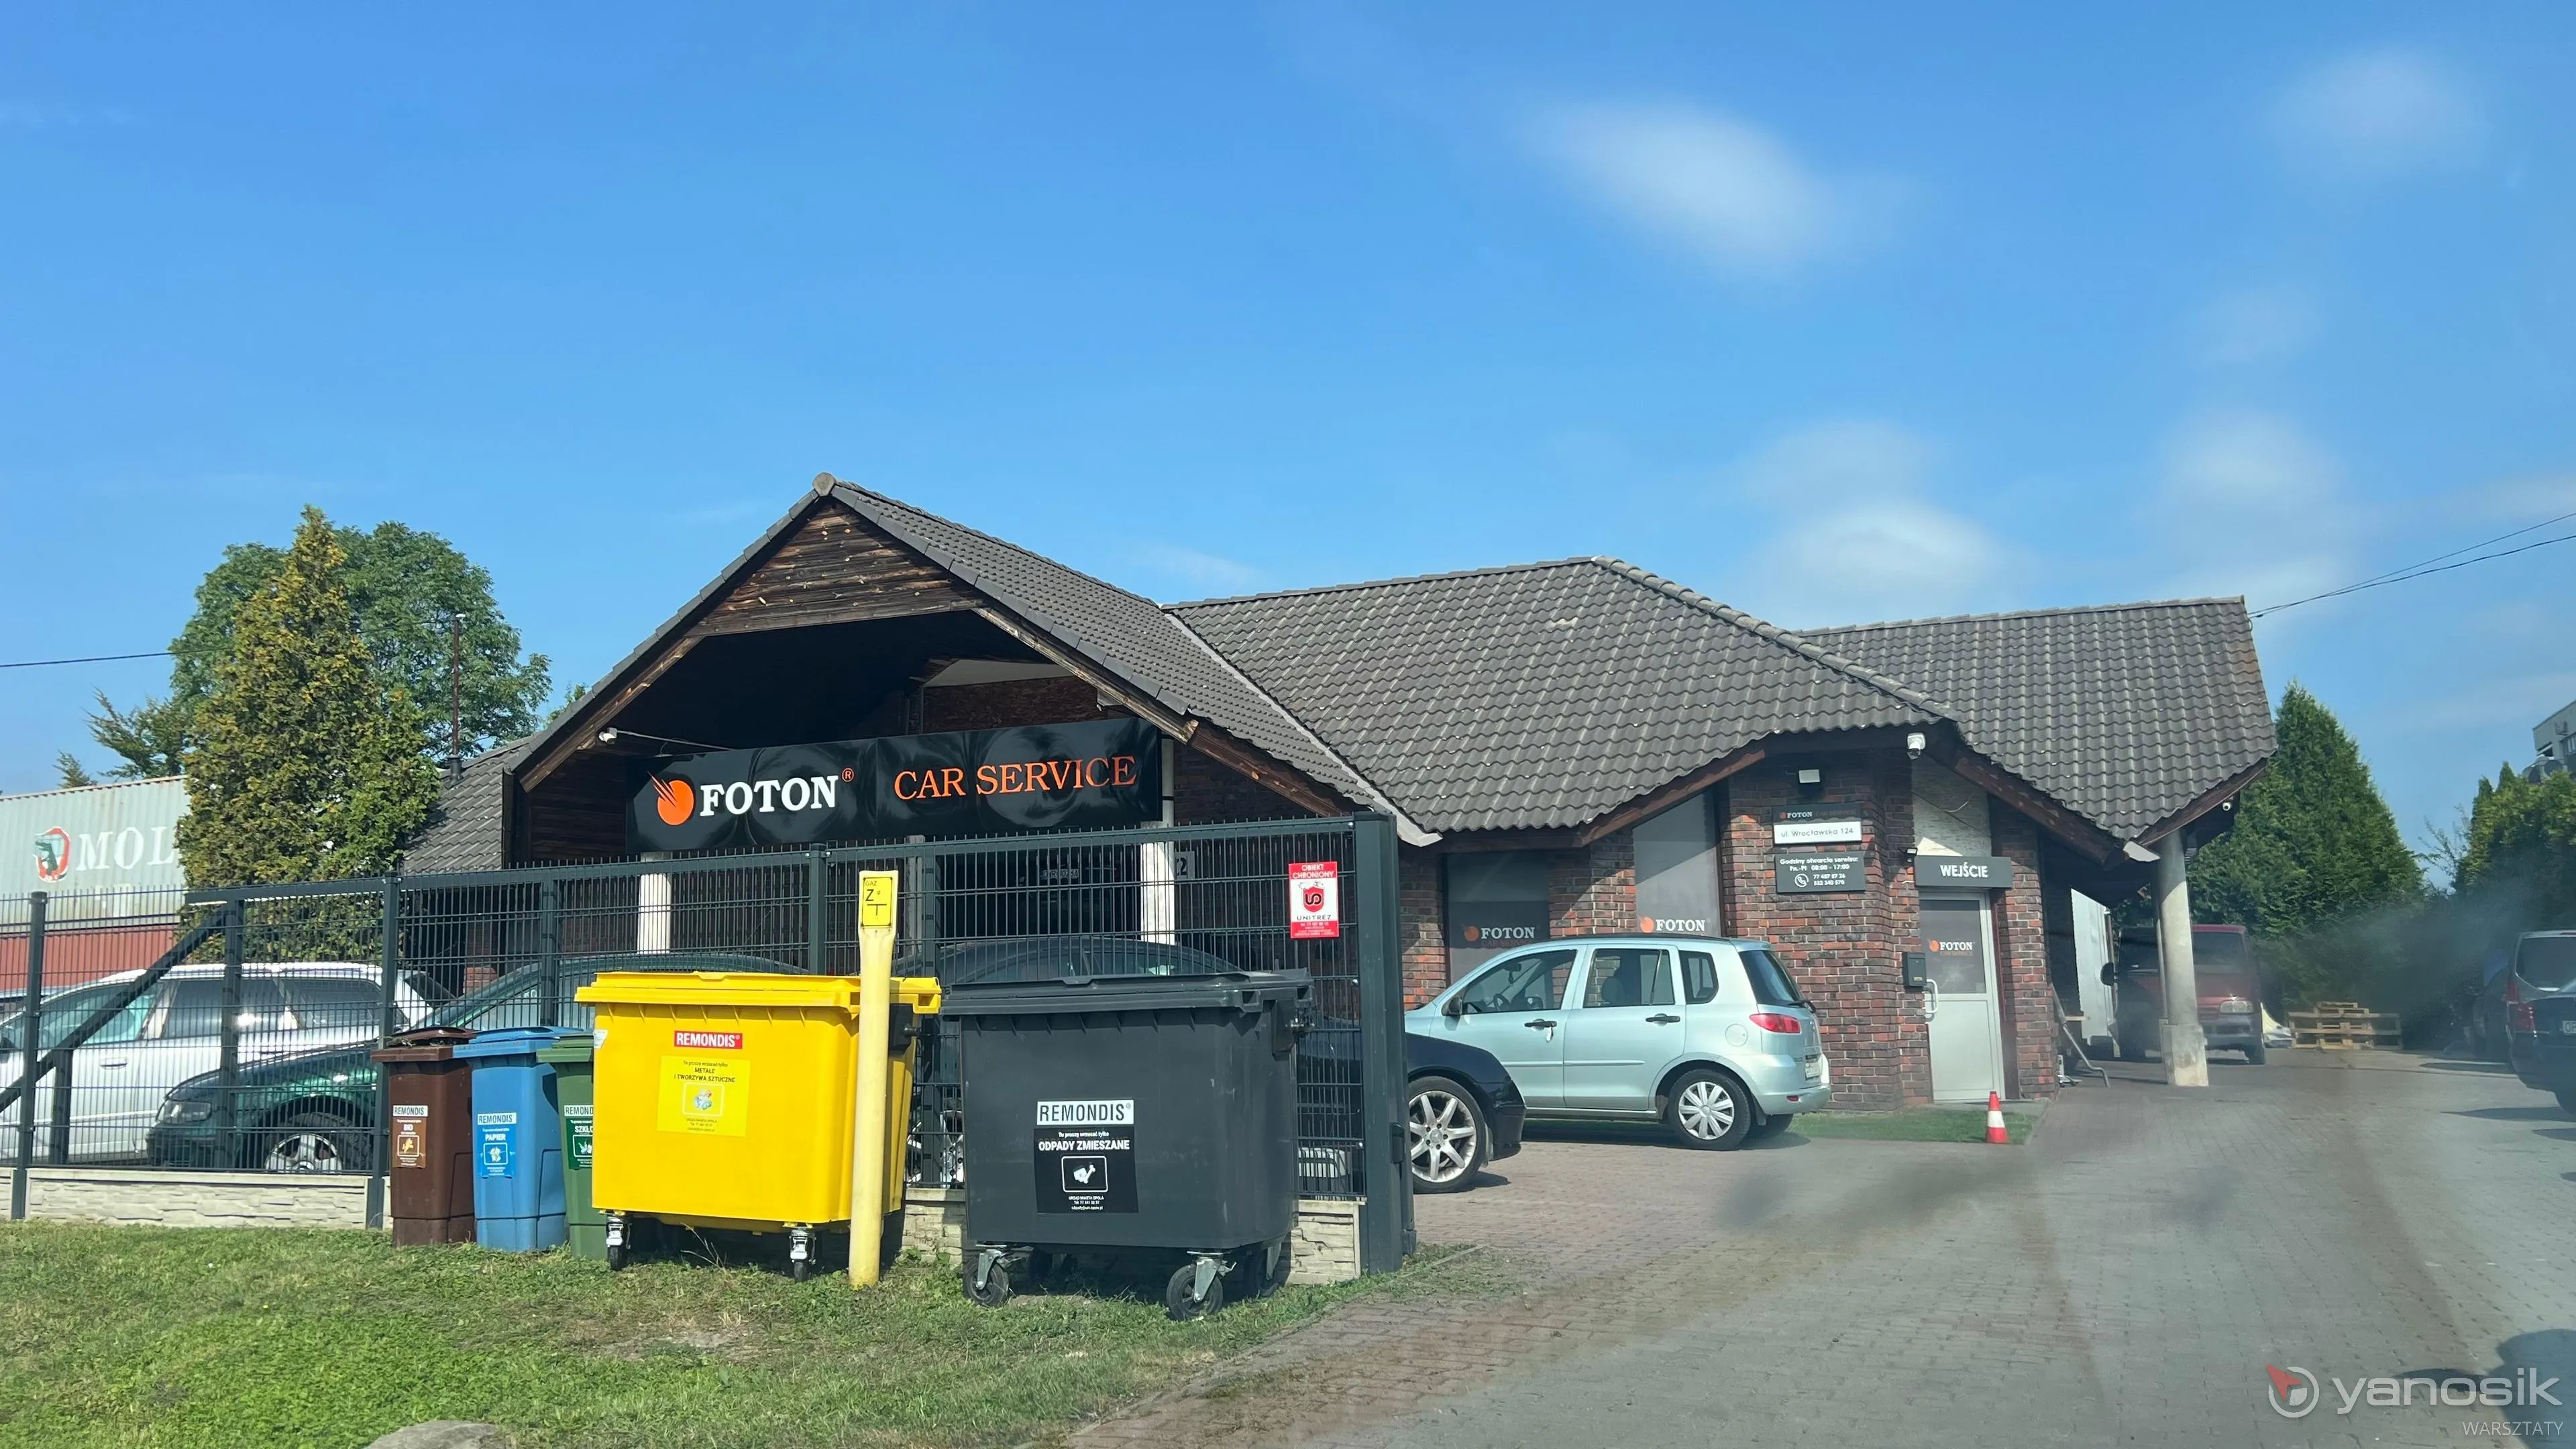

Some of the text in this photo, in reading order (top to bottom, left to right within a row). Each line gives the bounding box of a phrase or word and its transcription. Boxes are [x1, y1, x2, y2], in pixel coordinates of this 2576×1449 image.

[894, 755, 1137, 800] CAR SERVICE
[1792, 828, 1838, 837] Wrocławska
[75, 826, 175, 871] MOL
[1292, 871, 1334, 879] CHRONIONY
[1940, 861, 1989, 878] WEJŚCIE
[865, 889, 874, 901] Z
[1656, 919, 1705, 931] FOTON
[1481, 927, 1535, 939] FOTON
[1939, 942, 1972, 951] FOTON
[394, 1107, 424, 1115] REMONDIS
[479, 1114, 513, 1124] REMONDIS
[1038, 1139, 1130, 1151] ODPADY ZMIESZANE
